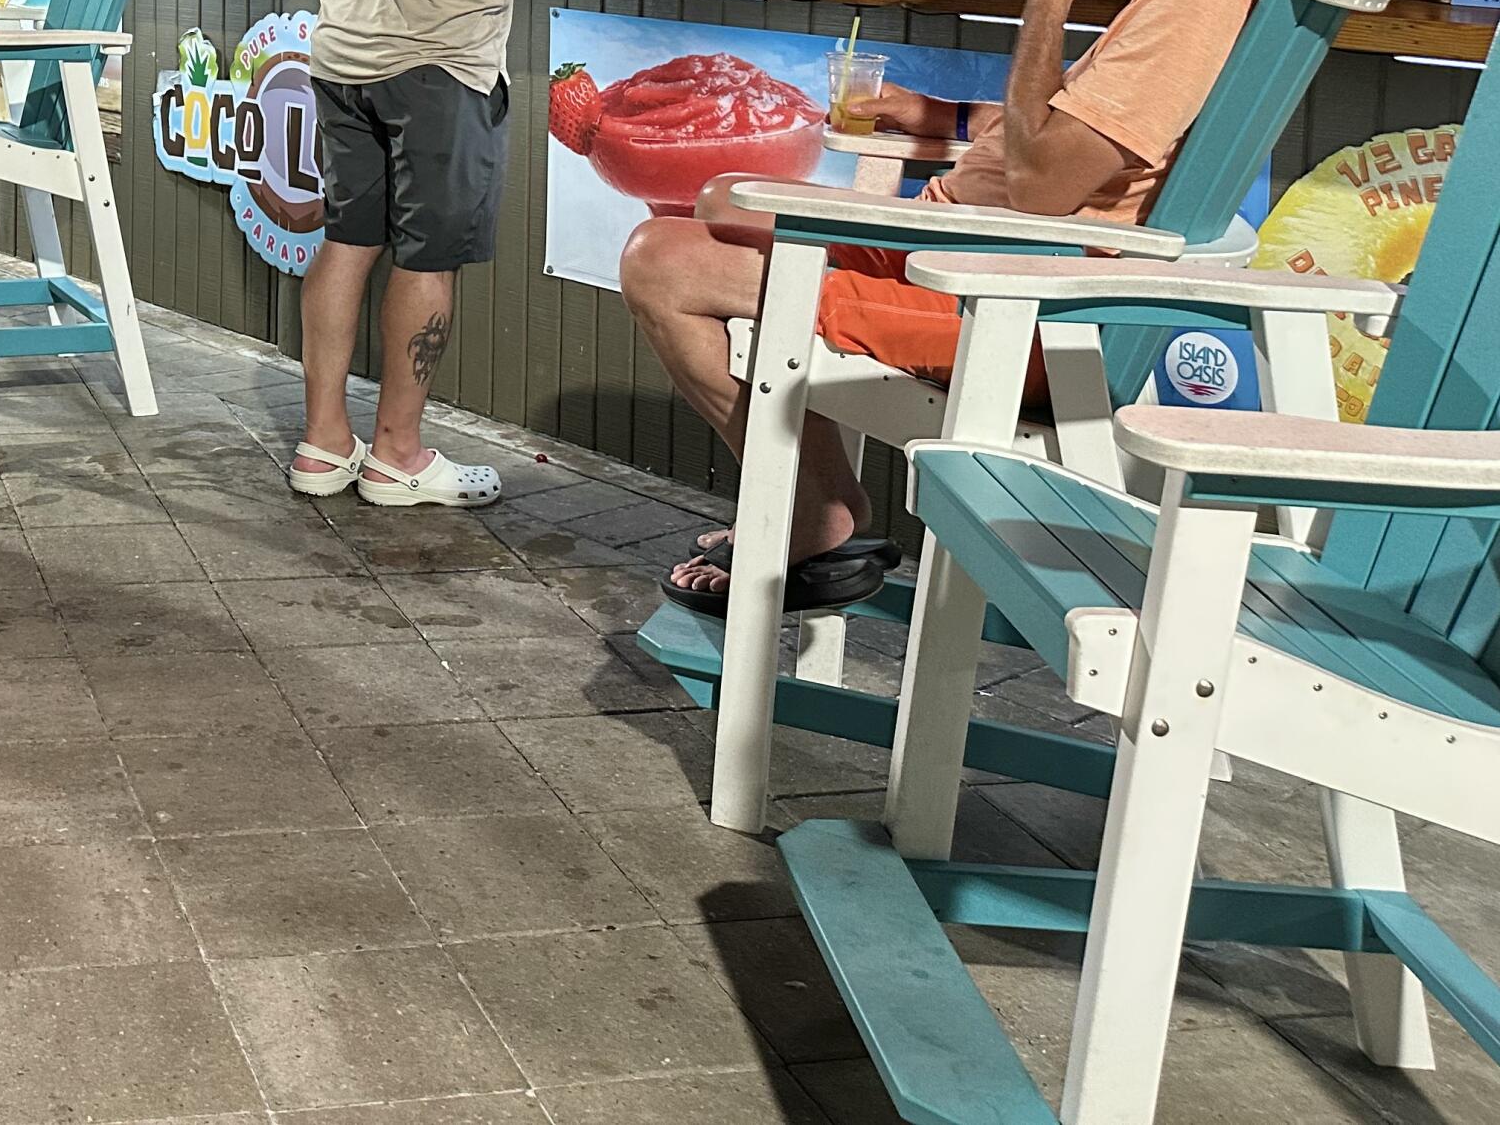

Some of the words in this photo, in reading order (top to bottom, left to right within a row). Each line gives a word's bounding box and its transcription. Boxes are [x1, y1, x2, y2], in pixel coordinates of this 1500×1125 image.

[240, 25, 276, 70] PURE
[161, 84, 264, 171] COCO
[1336, 141, 1402, 188] 1/2
[243, 207, 318, 264] PARADI
[1177, 361, 1224, 386] OASIS
[1180, 341, 1226, 367] ISLAND
